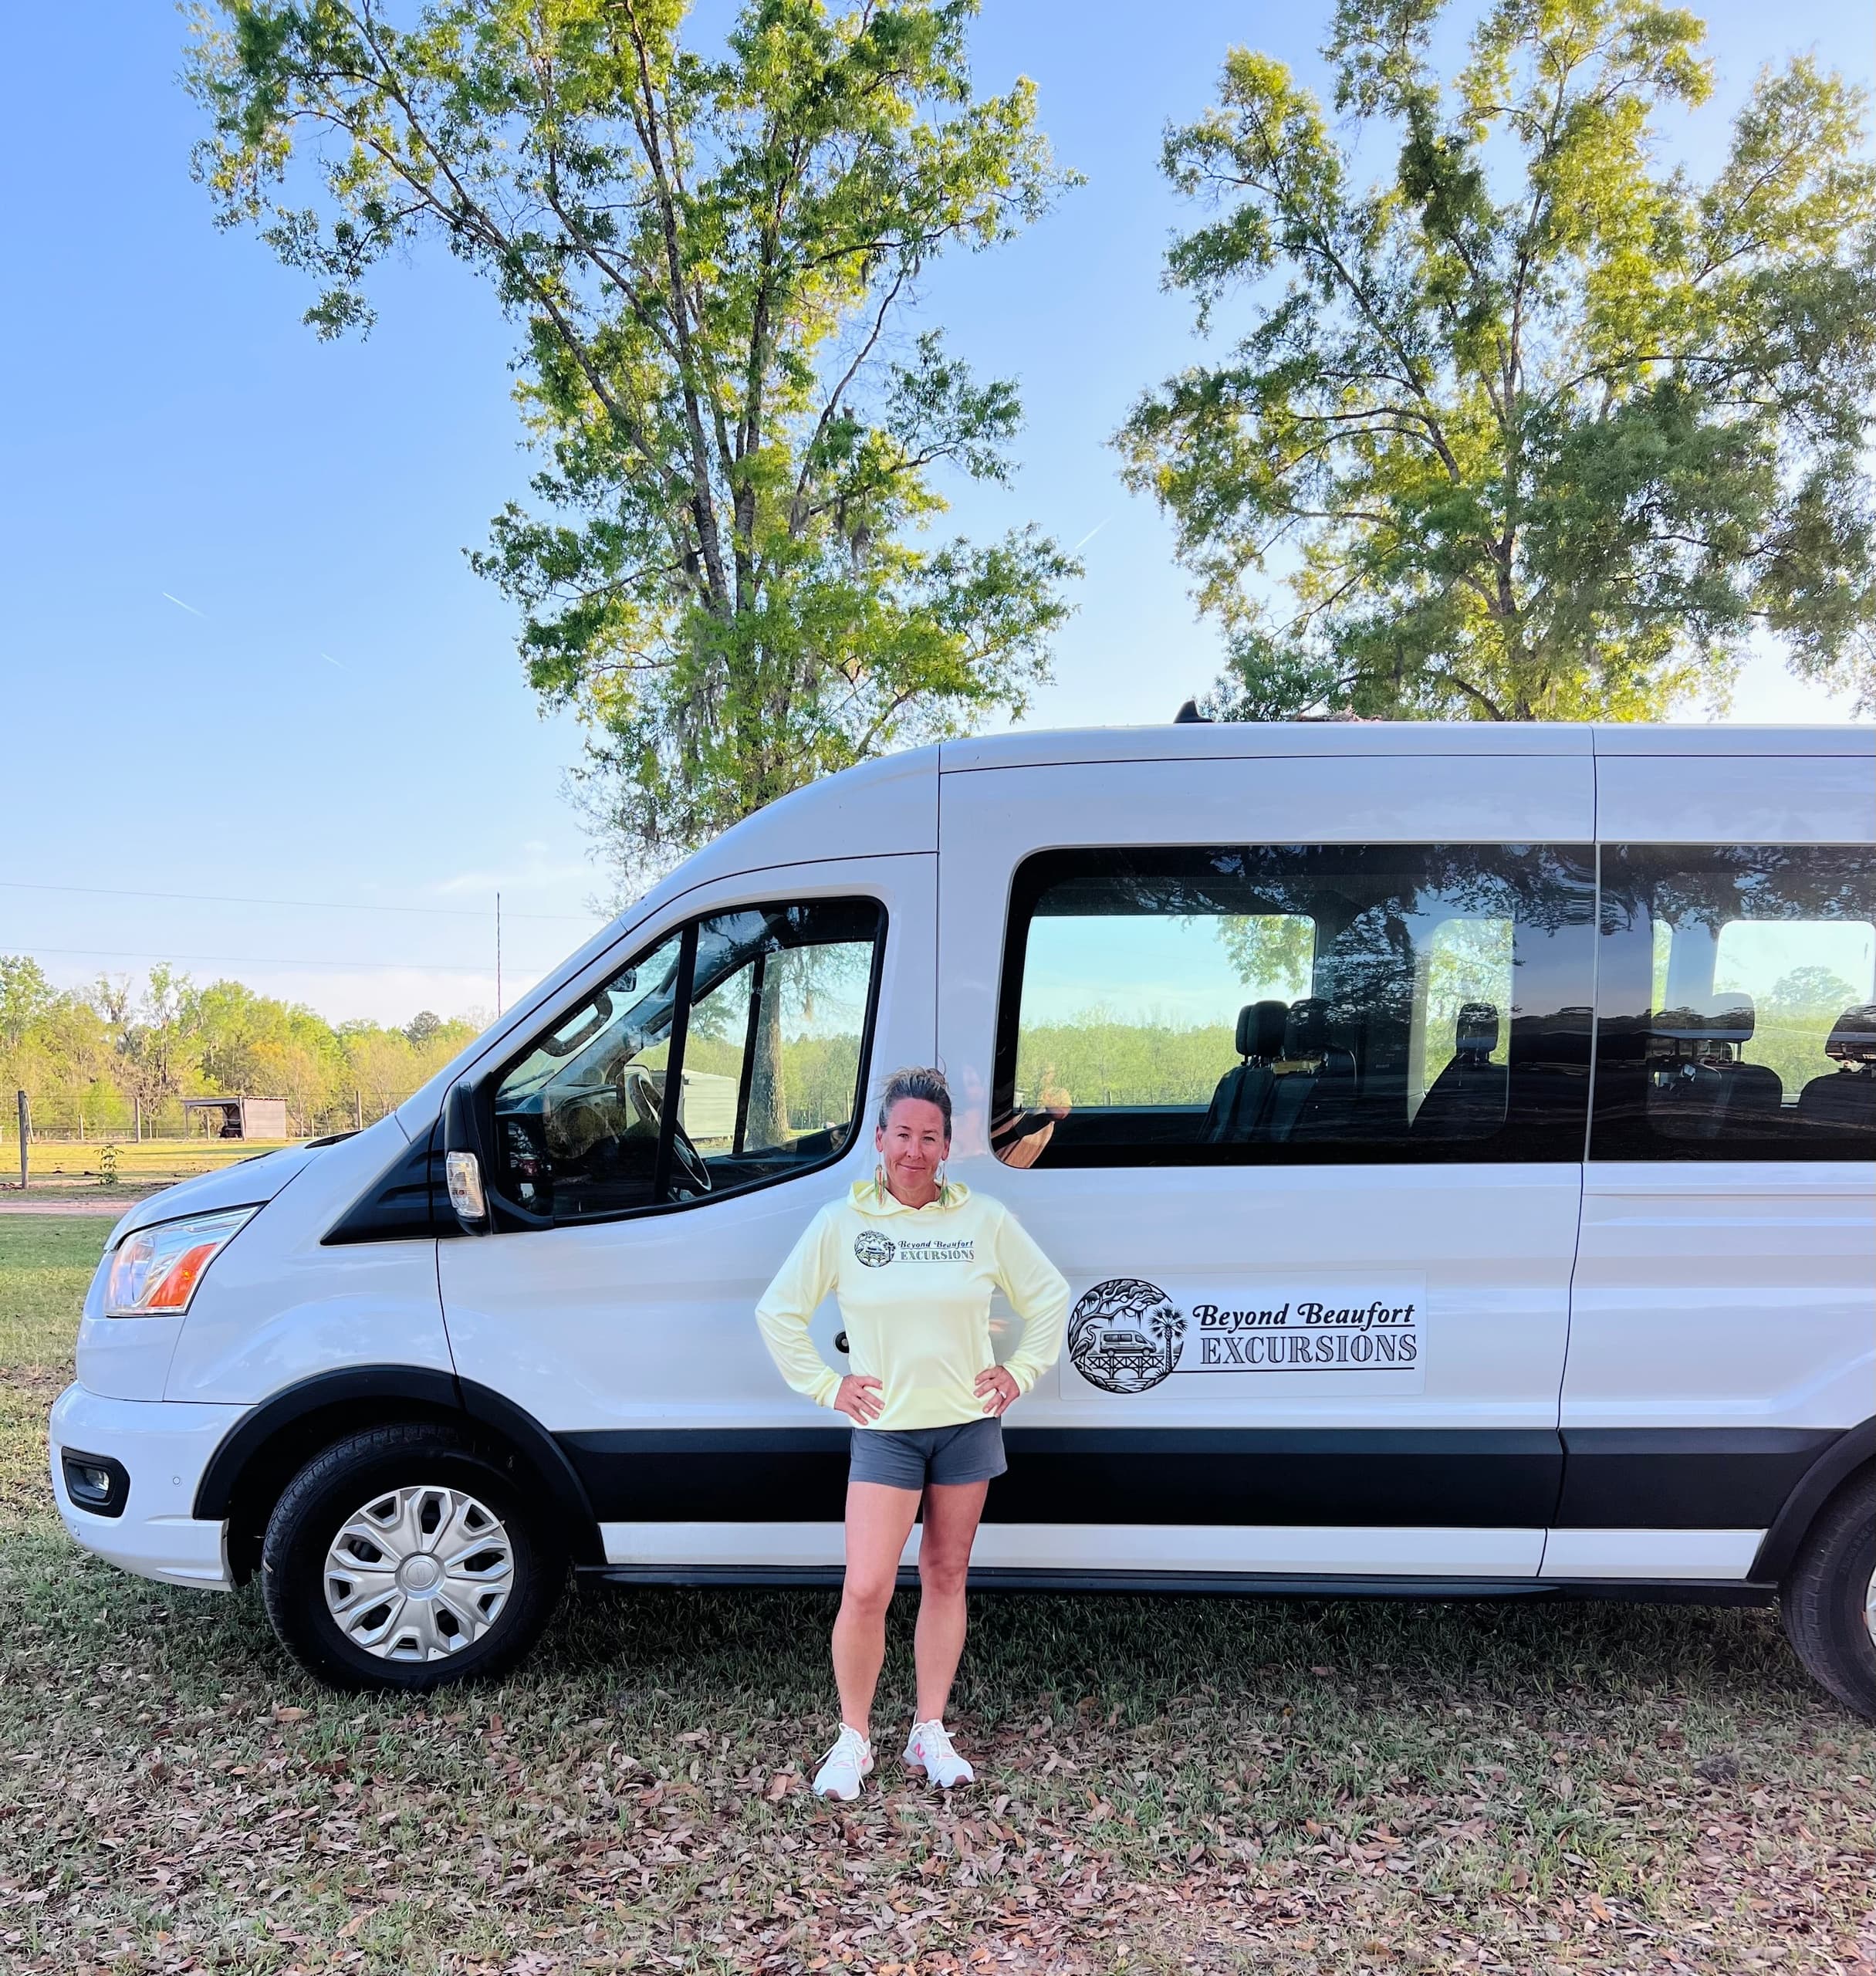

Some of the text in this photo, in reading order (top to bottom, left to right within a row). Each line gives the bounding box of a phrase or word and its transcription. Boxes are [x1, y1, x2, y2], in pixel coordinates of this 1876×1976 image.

[897, 1240, 973, 1250] Beyond Beaufort
[901, 1250, 975, 1260] EXCURSIONS
[1192, 1301, 1415, 1334] Beyond Beaufort
[1200, 1335, 1417, 1365] EXCURSIONS
